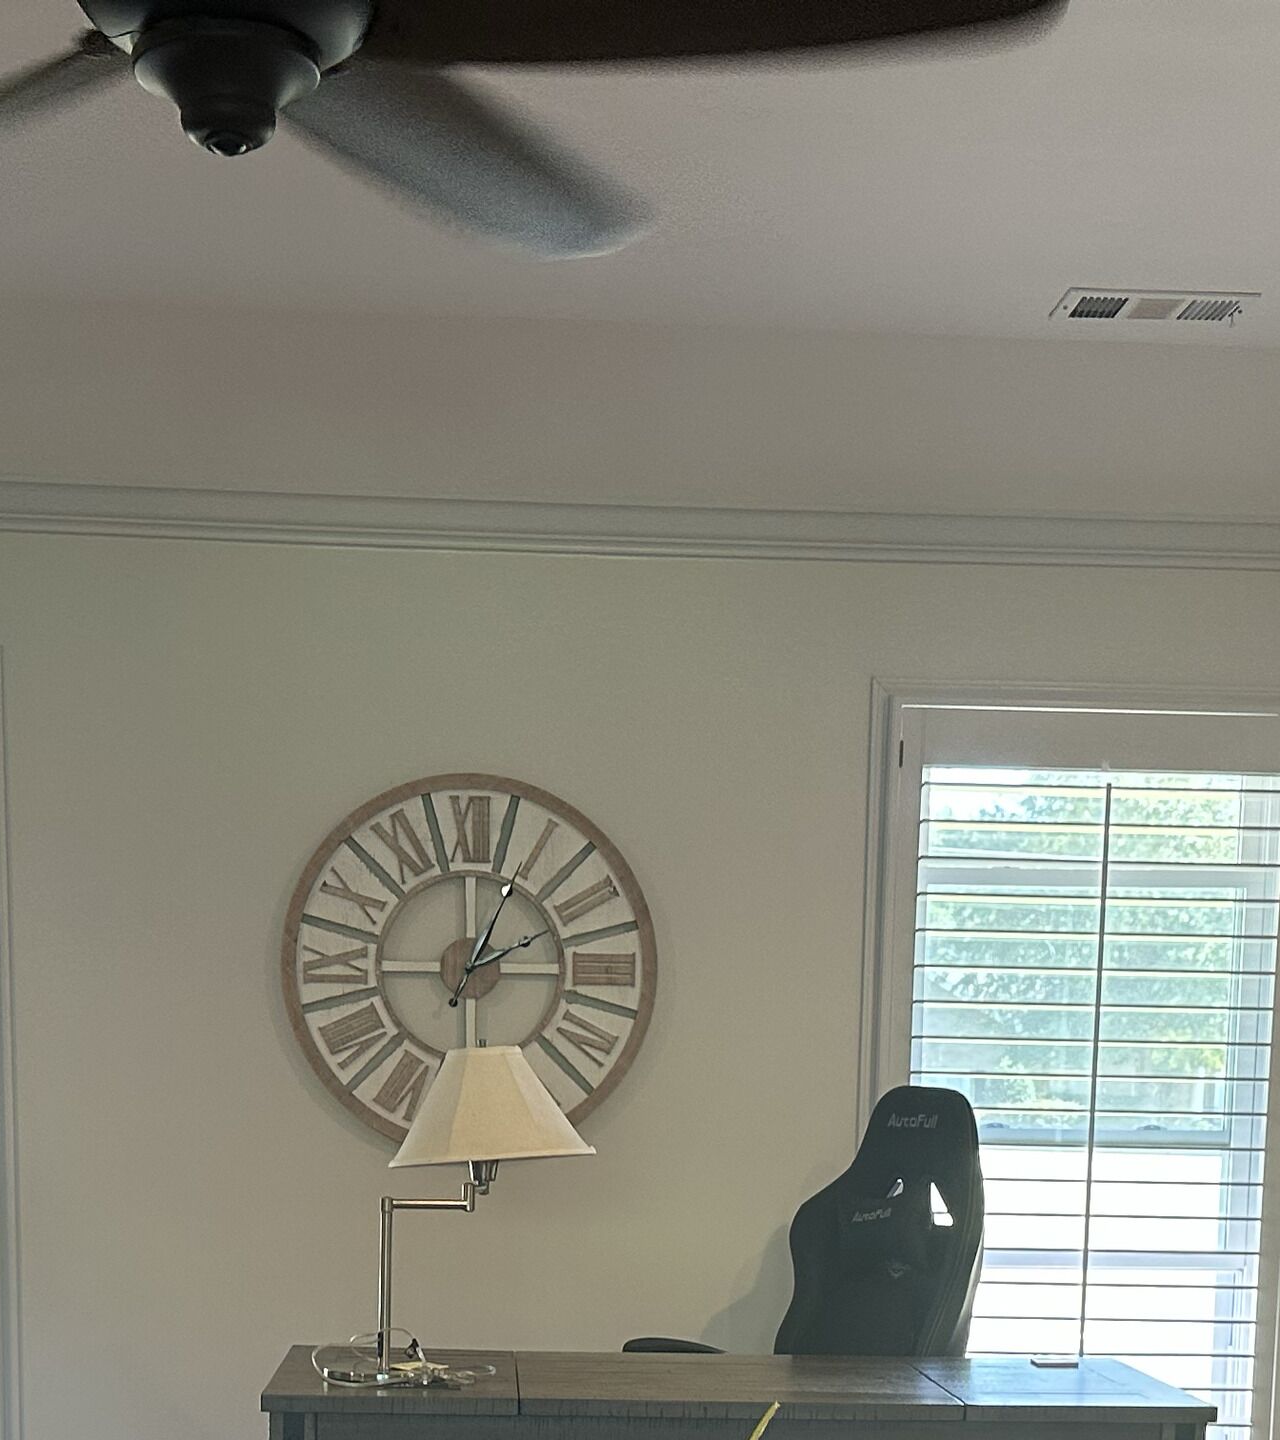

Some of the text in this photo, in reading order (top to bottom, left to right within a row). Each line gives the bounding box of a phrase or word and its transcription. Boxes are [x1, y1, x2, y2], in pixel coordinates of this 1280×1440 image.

[369, 808, 435, 884] XI
[449, 795, 491, 863] XII
[519, 818, 559, 881] I
[320, 866, 387, 925] X
[553, 873, 620, 927] II
[303, 944, 368, 985] IX
[572, 951, 635, 987] III
[318, 1001, 387, 1071] VIII
[556, 1009, 619, 1068] IV
[372, 1048, 429, 1122] VII
[887, 1112, 939, 1129] AutoFull
